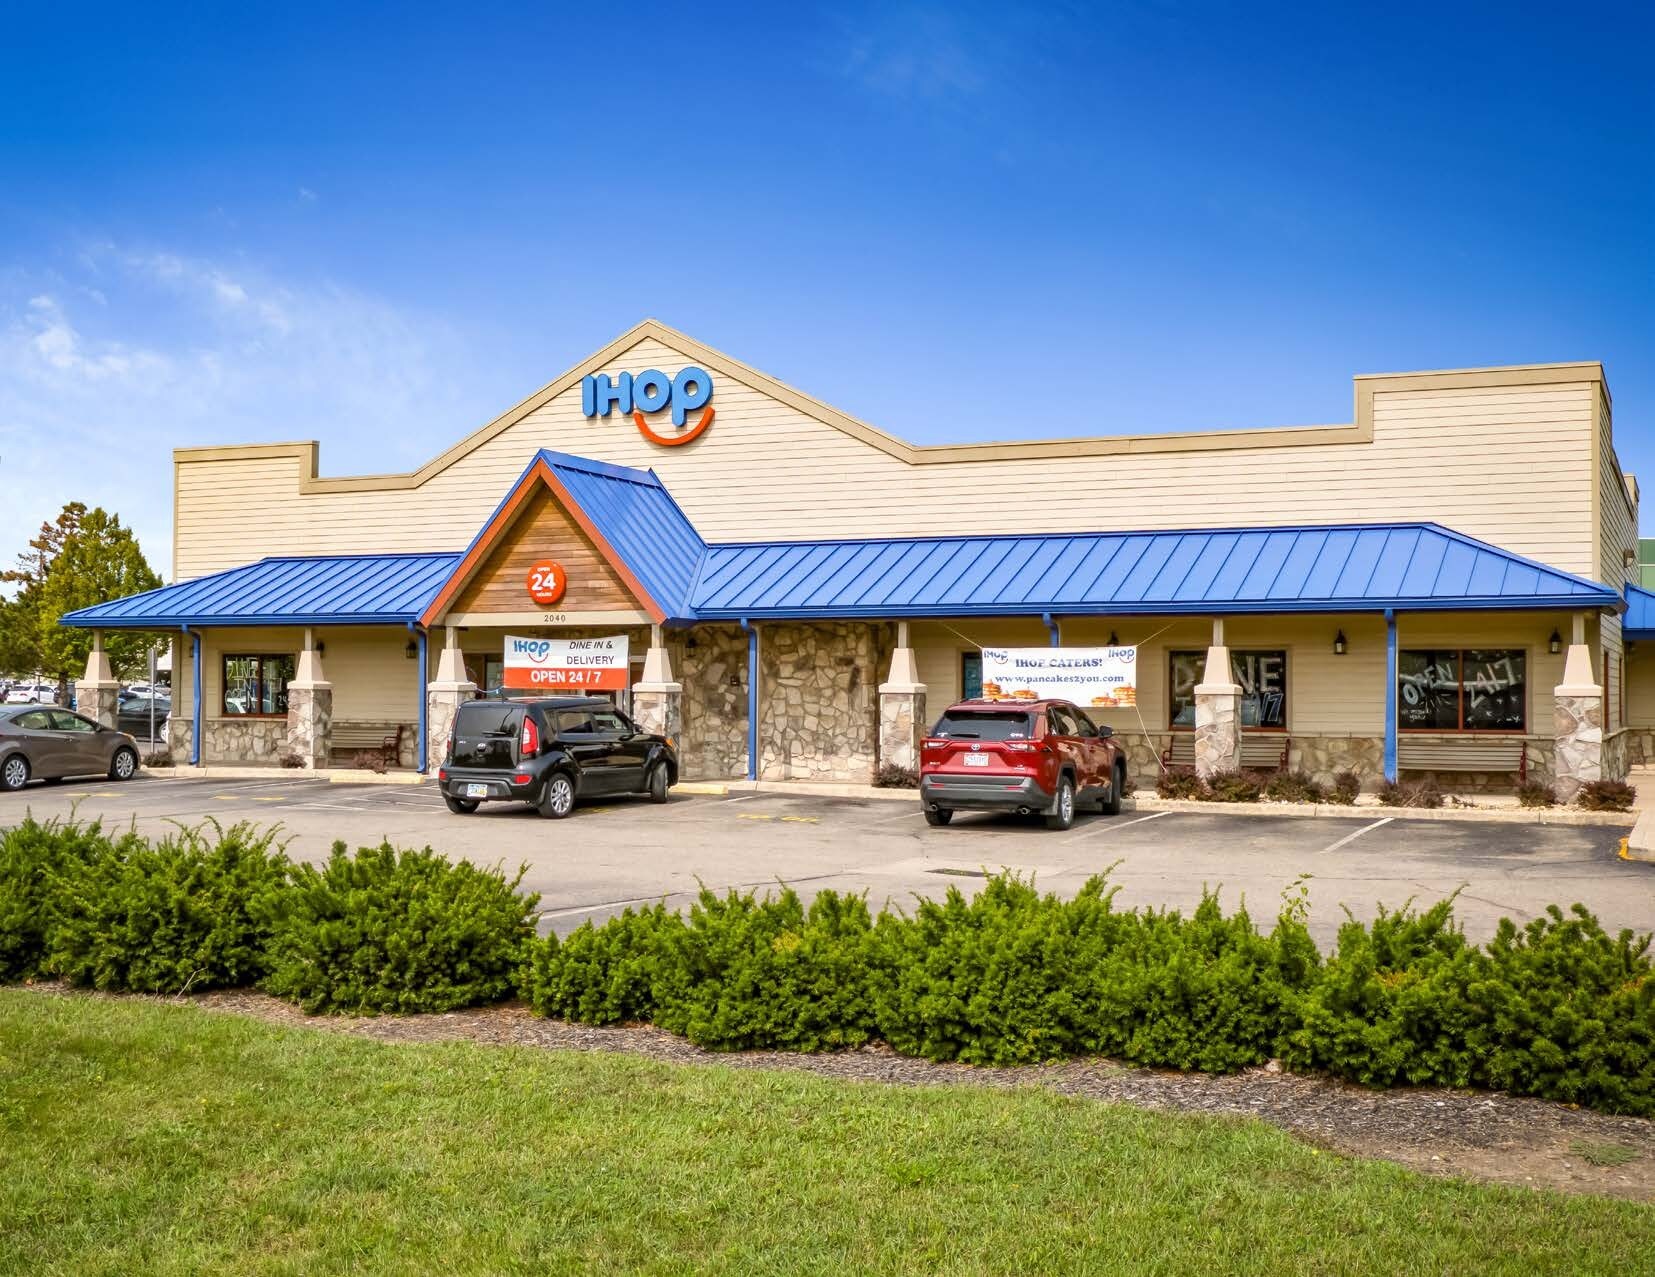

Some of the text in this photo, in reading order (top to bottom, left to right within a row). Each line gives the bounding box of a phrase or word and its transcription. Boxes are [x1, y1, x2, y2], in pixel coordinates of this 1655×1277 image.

[531, 573, 556, 591] 24
[544, 614, 566, 622] 2040
[569, 640, 615, 650] DINE IN &
[566, 655, 615, 665] DELIVERY
[1015, 657, 1104, 669] IHOP CATERS!
[530, 670, 566, 682] OPEN
[568, 671, 584, 683] 24
[995, 673, 1125, 685] www.pancakes2you.com
